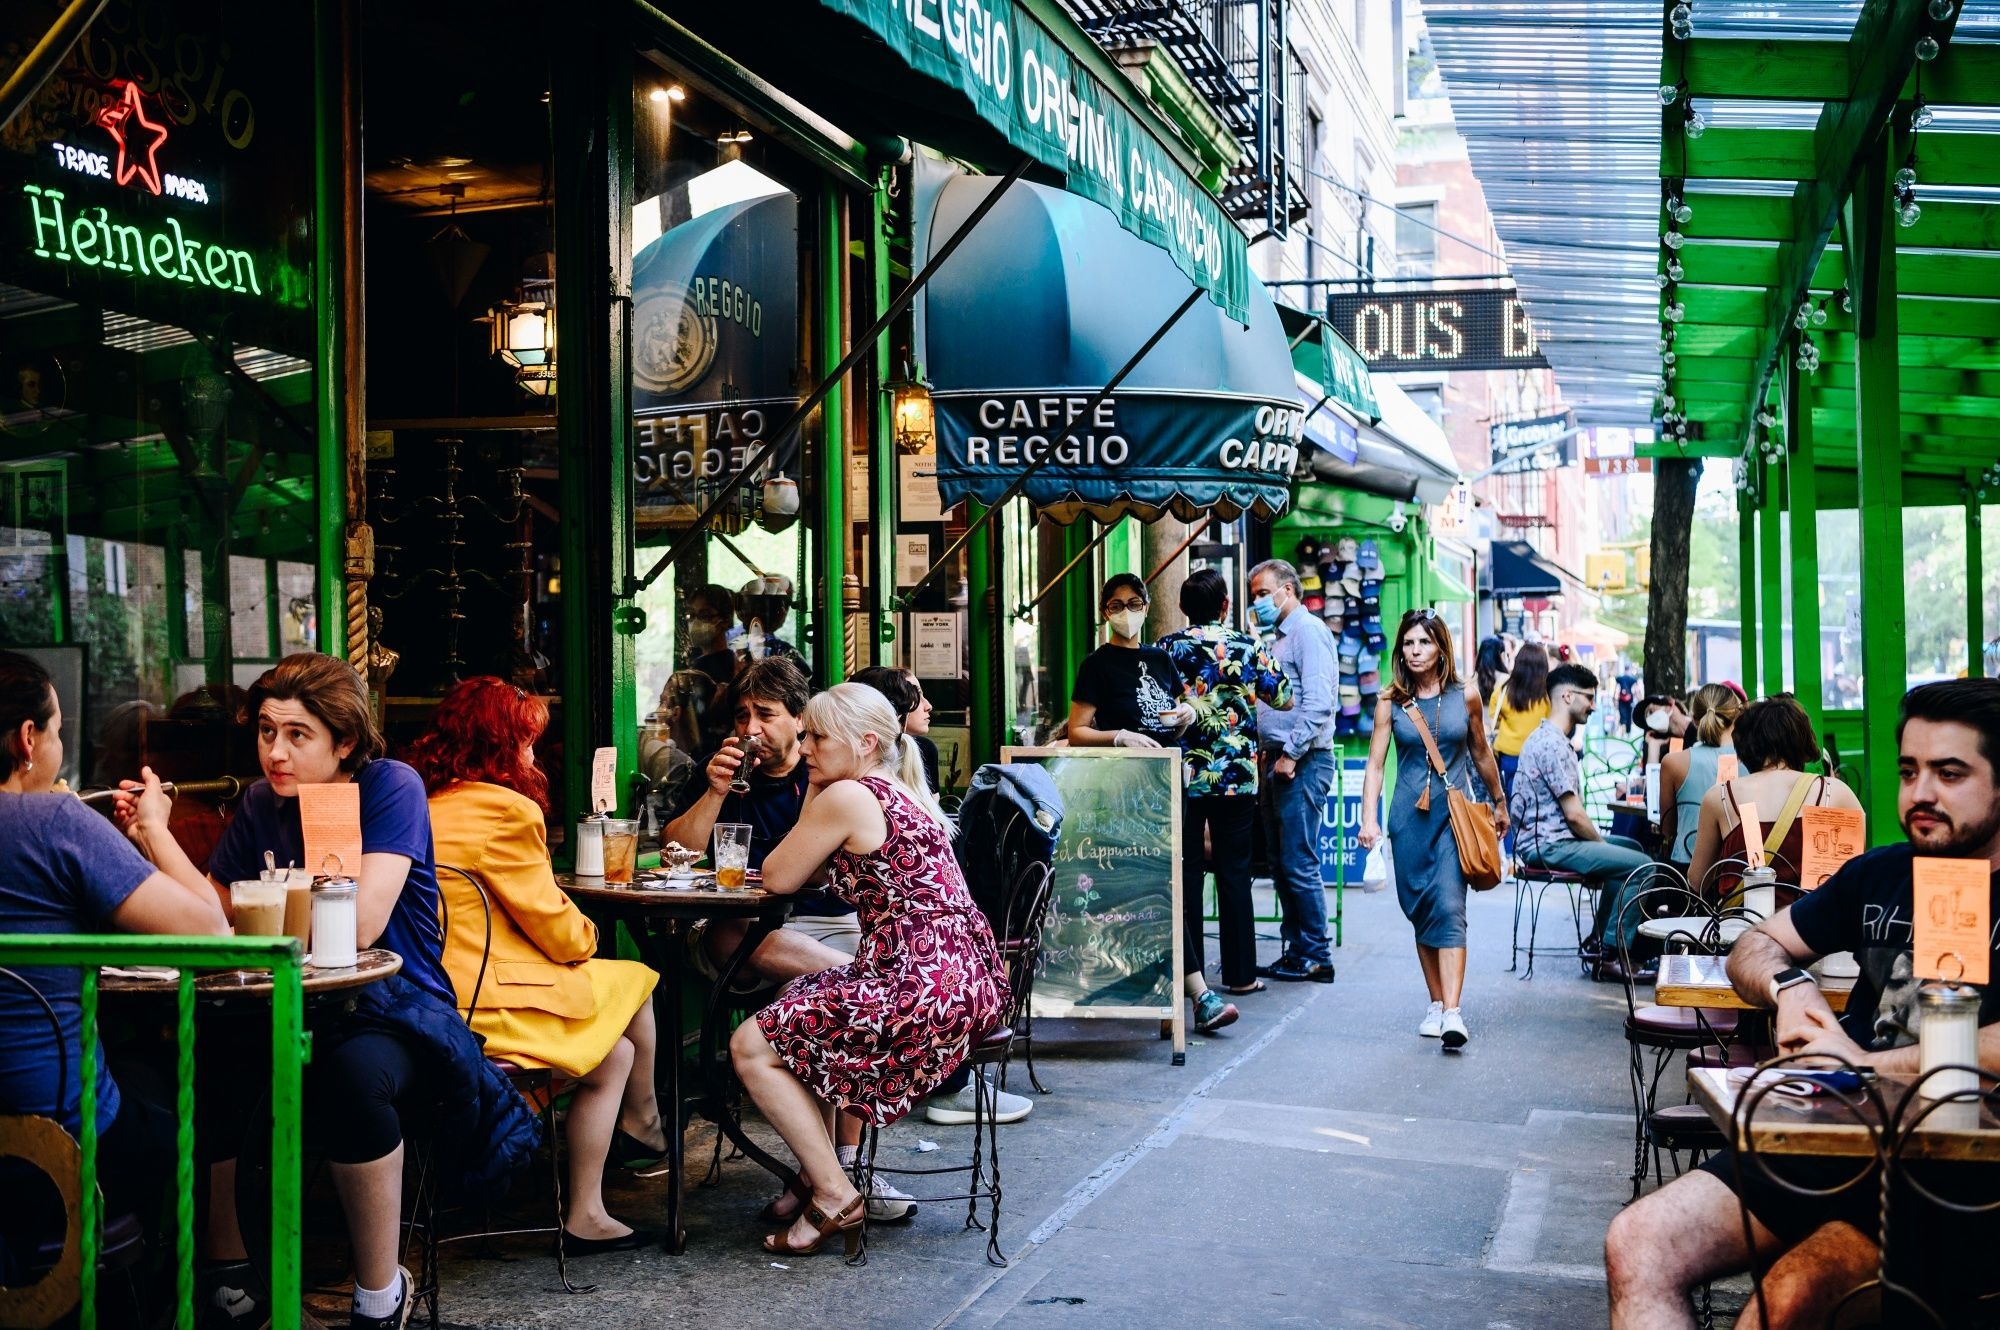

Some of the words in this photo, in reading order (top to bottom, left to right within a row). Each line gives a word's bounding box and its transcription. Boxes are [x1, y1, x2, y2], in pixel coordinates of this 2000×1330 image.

[53, 142, 111, 179] TRADE
[164, 173, 208, 205] MARK
[1023, 49, 1124, 199] ORIGINAL
[1130, 147, 1222, 281] CAPPUCCINO
[23, 184, 261, 296] Heineken
[695, 277, 762, 338] REGGIO
[1355, 301, 1462, 361] OUS
[979, 398, 1115, 430] CAFFE
[967, 435, 1129, 467] REGGIO
[1599, 459, 1609, 472] W
[1614, 459, 1622, 472] 3
[1626, 459, 1639, 473] St
[1318, 803, 1363, 829] UU
[1052, 840, 1073, 862] ed
[1077, 837, 1161, 870] Cappucino
[1320, 836, 1359, 851] SOLD
